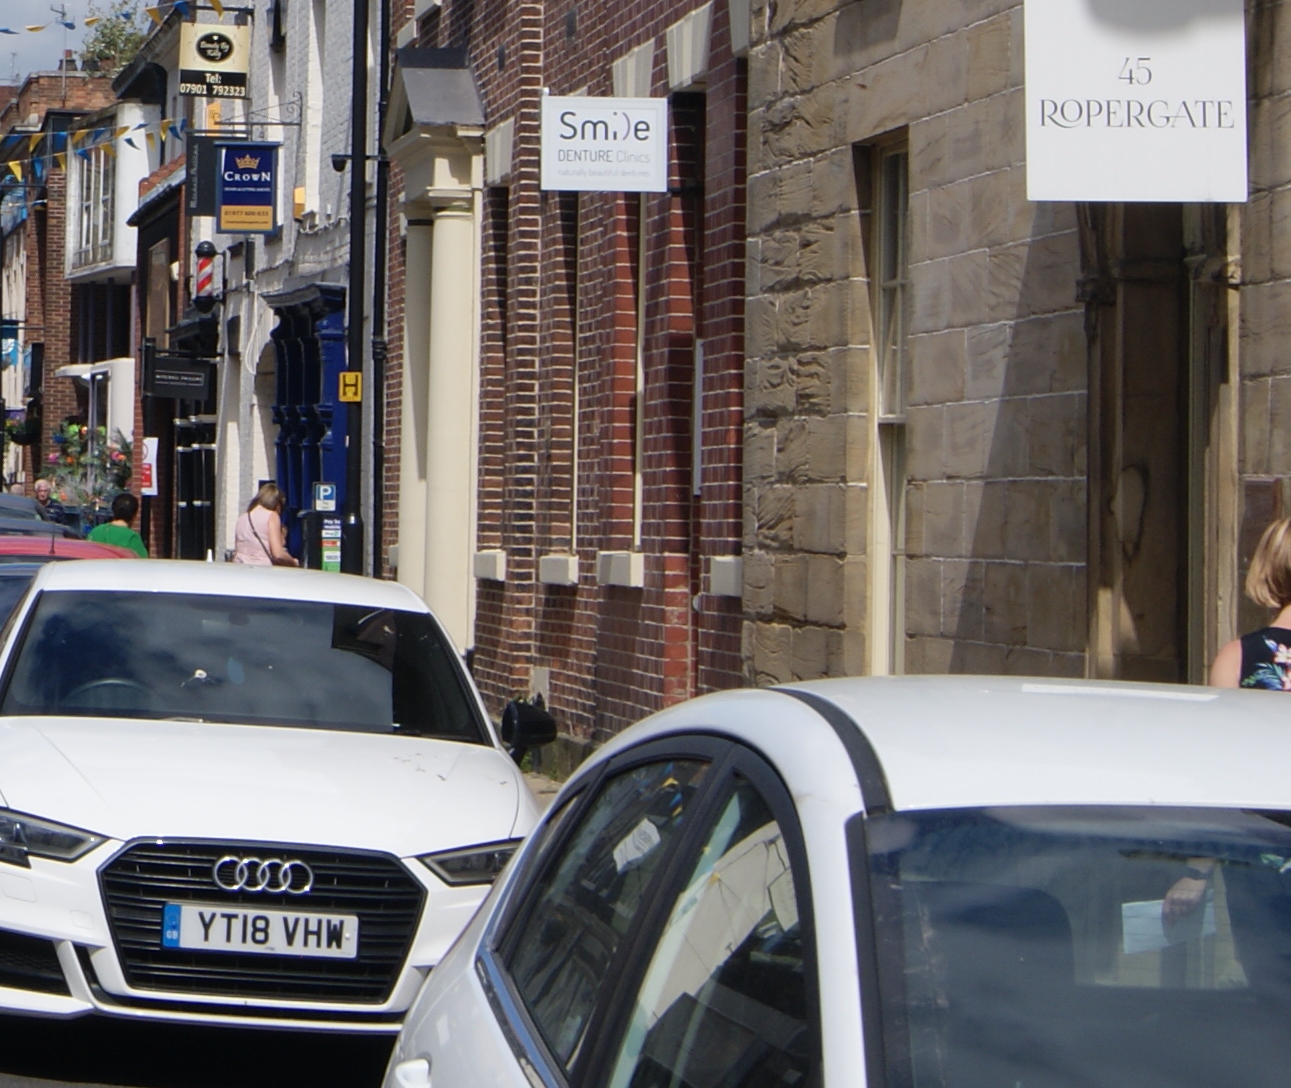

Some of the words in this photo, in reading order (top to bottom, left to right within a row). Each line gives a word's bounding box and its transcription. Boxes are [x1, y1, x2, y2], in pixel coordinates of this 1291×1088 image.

[1118, 56, 1152, 85] 45
[179, 83, 207, 94] 07901
[1039, 99, 1235, 129] ROPERGATE
[557, 149, 613, 163] DENTURE
[616, 150, 651, 164] Clinics
[319, 485, 332, 500] P
[198, 911, 270, 945] YT18
[282, 916, 345, 950] VHW
